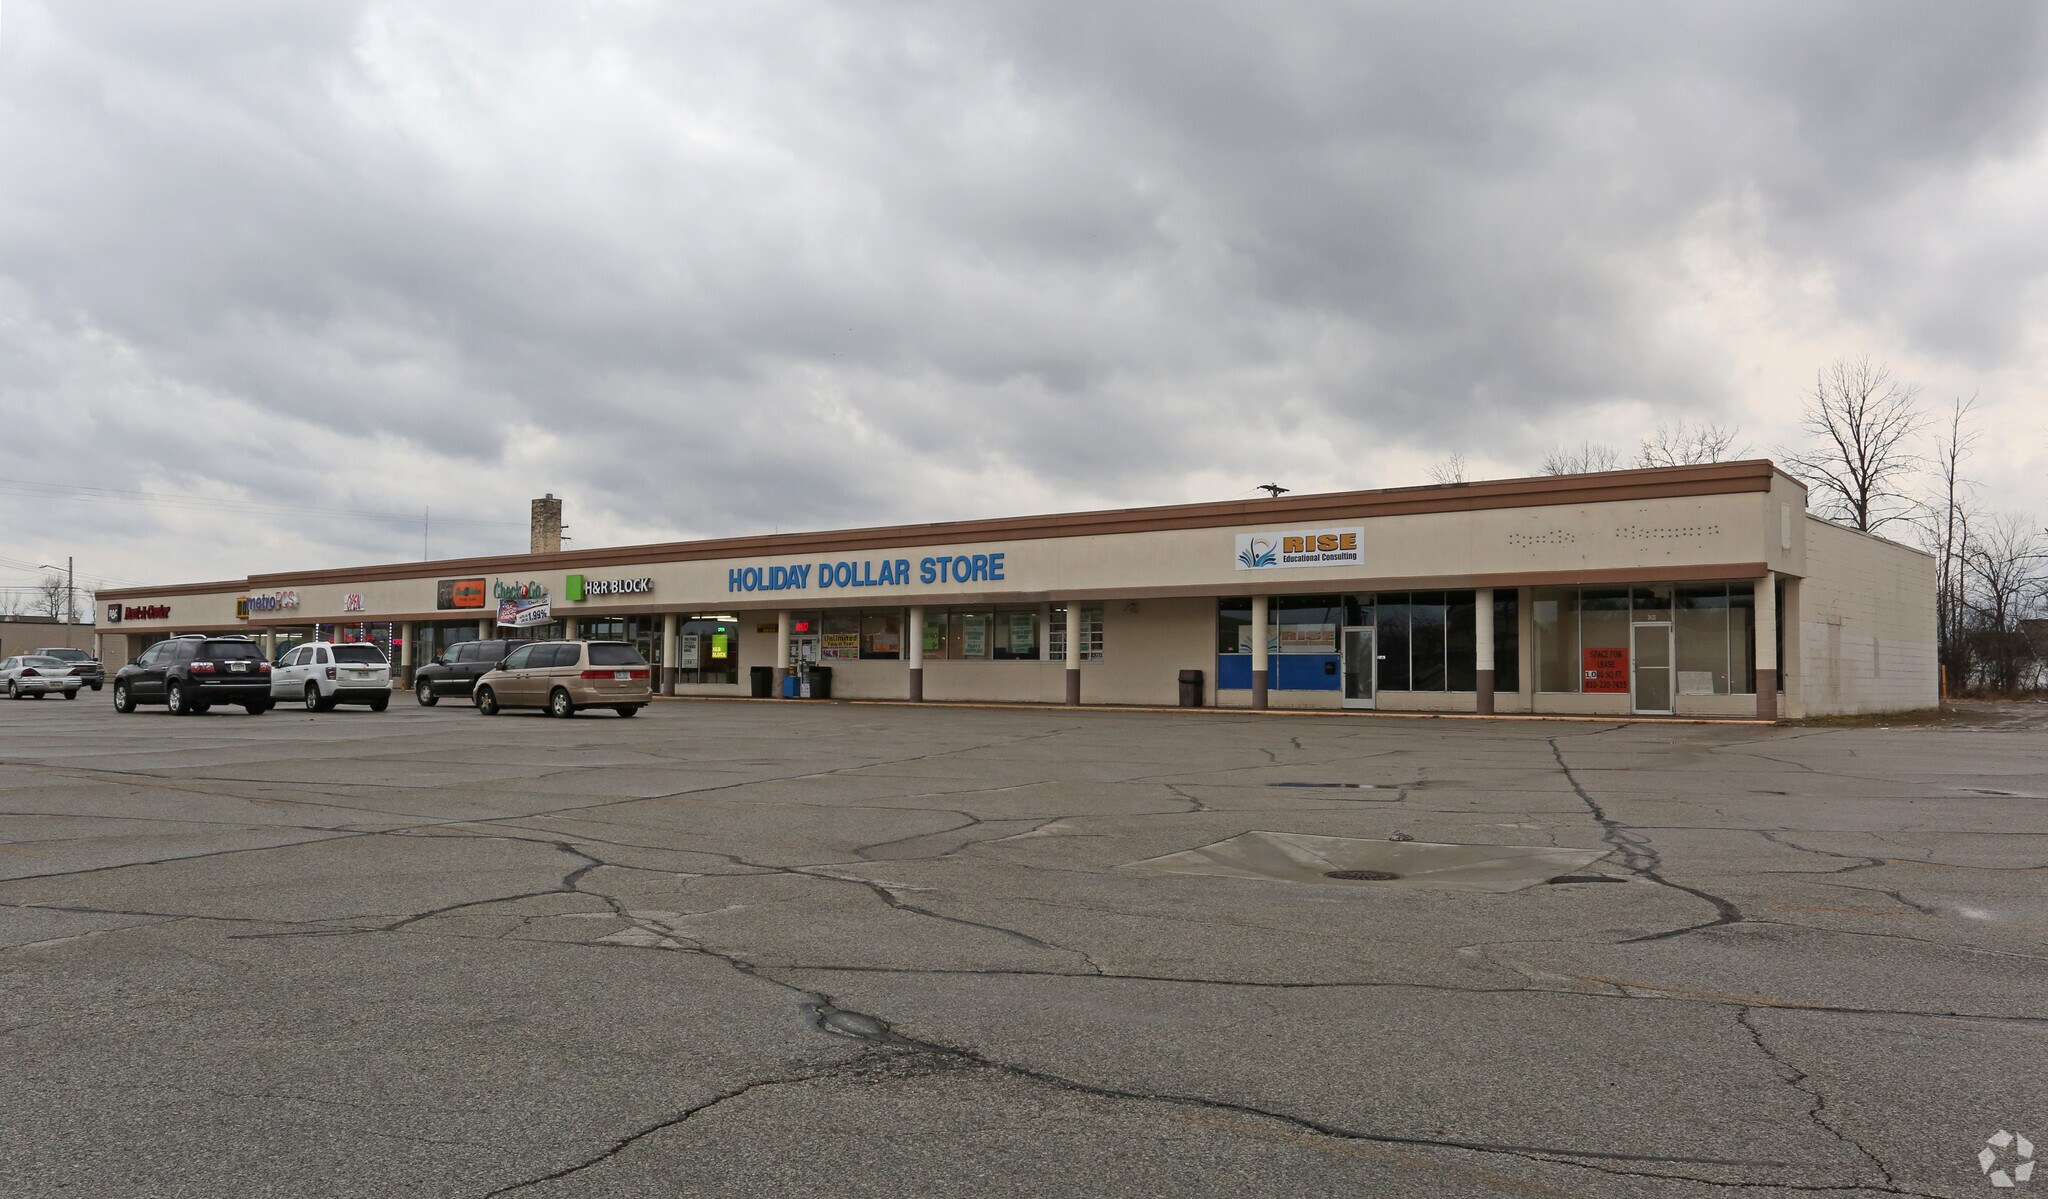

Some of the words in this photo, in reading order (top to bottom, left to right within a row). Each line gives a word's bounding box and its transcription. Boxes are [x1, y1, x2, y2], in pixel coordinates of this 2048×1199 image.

[1283, 533, 1357, 553] RISE
[1283, 553, 1320, 563] Educational
[1321, 552, 1357, 561] Consulting
[728, 563, 811, 592] HOLIDAY
[818, 559, 910, 588] DOLLAR
[920, 553, 1005, 584] STORE
[585, 581, 608, 595] H&R
[611, 578, 649, 593] BLOCK
[246, 591, 295, 610] metroPCS
[1597, 660, 1616, 668] LEASE
